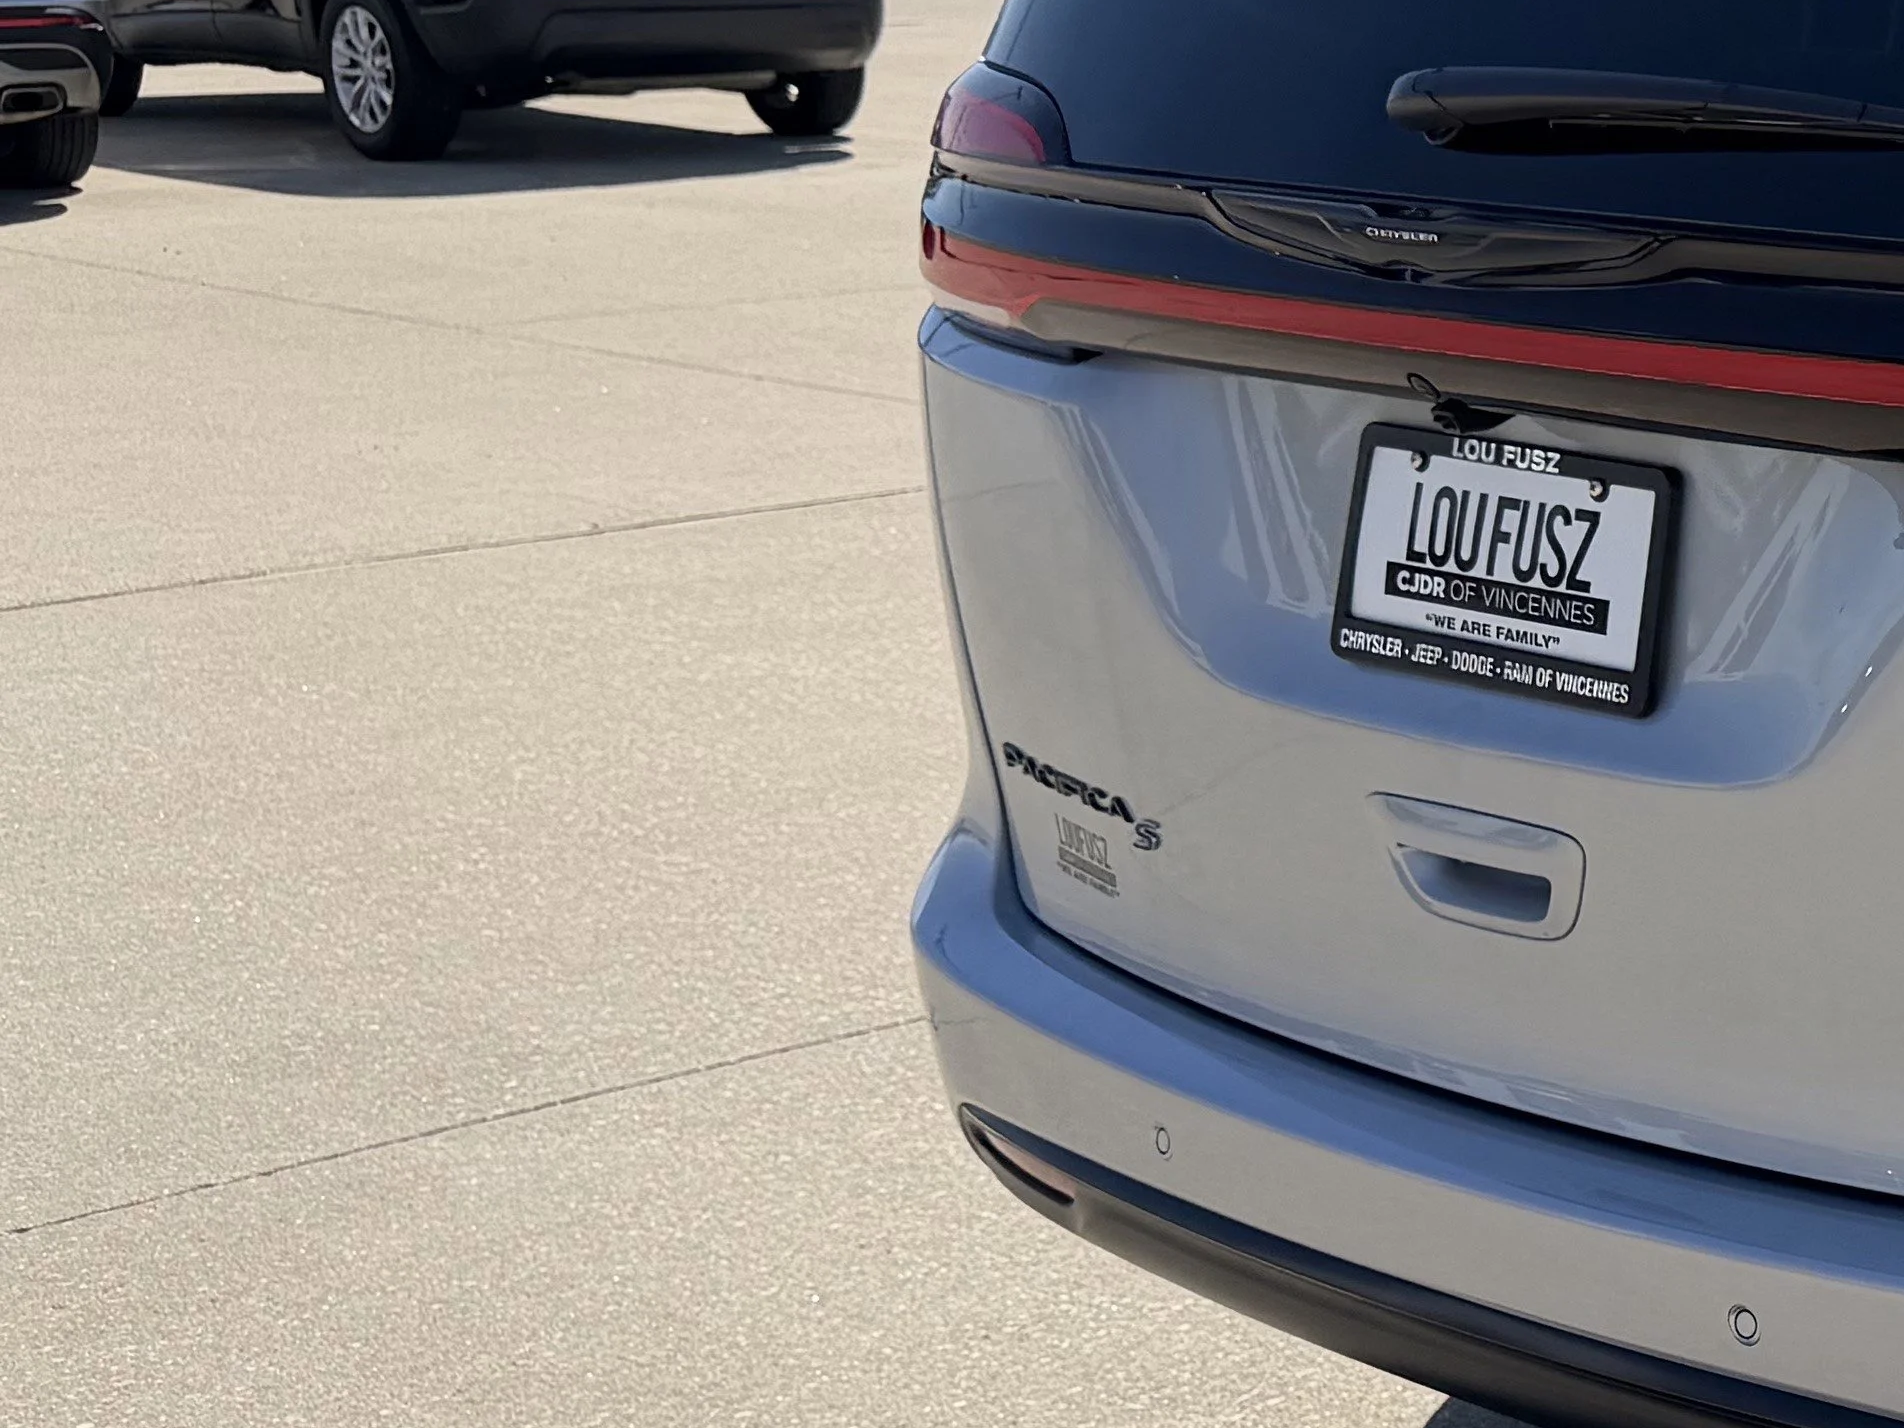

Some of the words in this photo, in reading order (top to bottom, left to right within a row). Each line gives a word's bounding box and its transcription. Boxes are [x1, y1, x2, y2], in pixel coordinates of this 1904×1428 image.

[1452, 437, 1496, 465] LOU
[1502, 445, 1561, 474] FUSZ
[1405, 482, 1489, 572] LOU
[1486, 495, 1602, 593] FUSZ
[1396, 570, 1446, 598] CJDR
[1450, 579, 1476, 602] OF
[1482, 585, 1595, 626] VINCENNES
[1460, 618, 1491, 638] ARE
[1340, 628, 1403, 659] CHRYSLER
[1411, 643, 1443, 666] JEEP
[1451, 650, 1494, 678] DODGE
[1503, 660, 1533, 685] RAM
[1536, 667, 1554, 688] OF
[1556, 671, 1630, 704] VINCENNES
[1133, 819, 1162, 851] S
